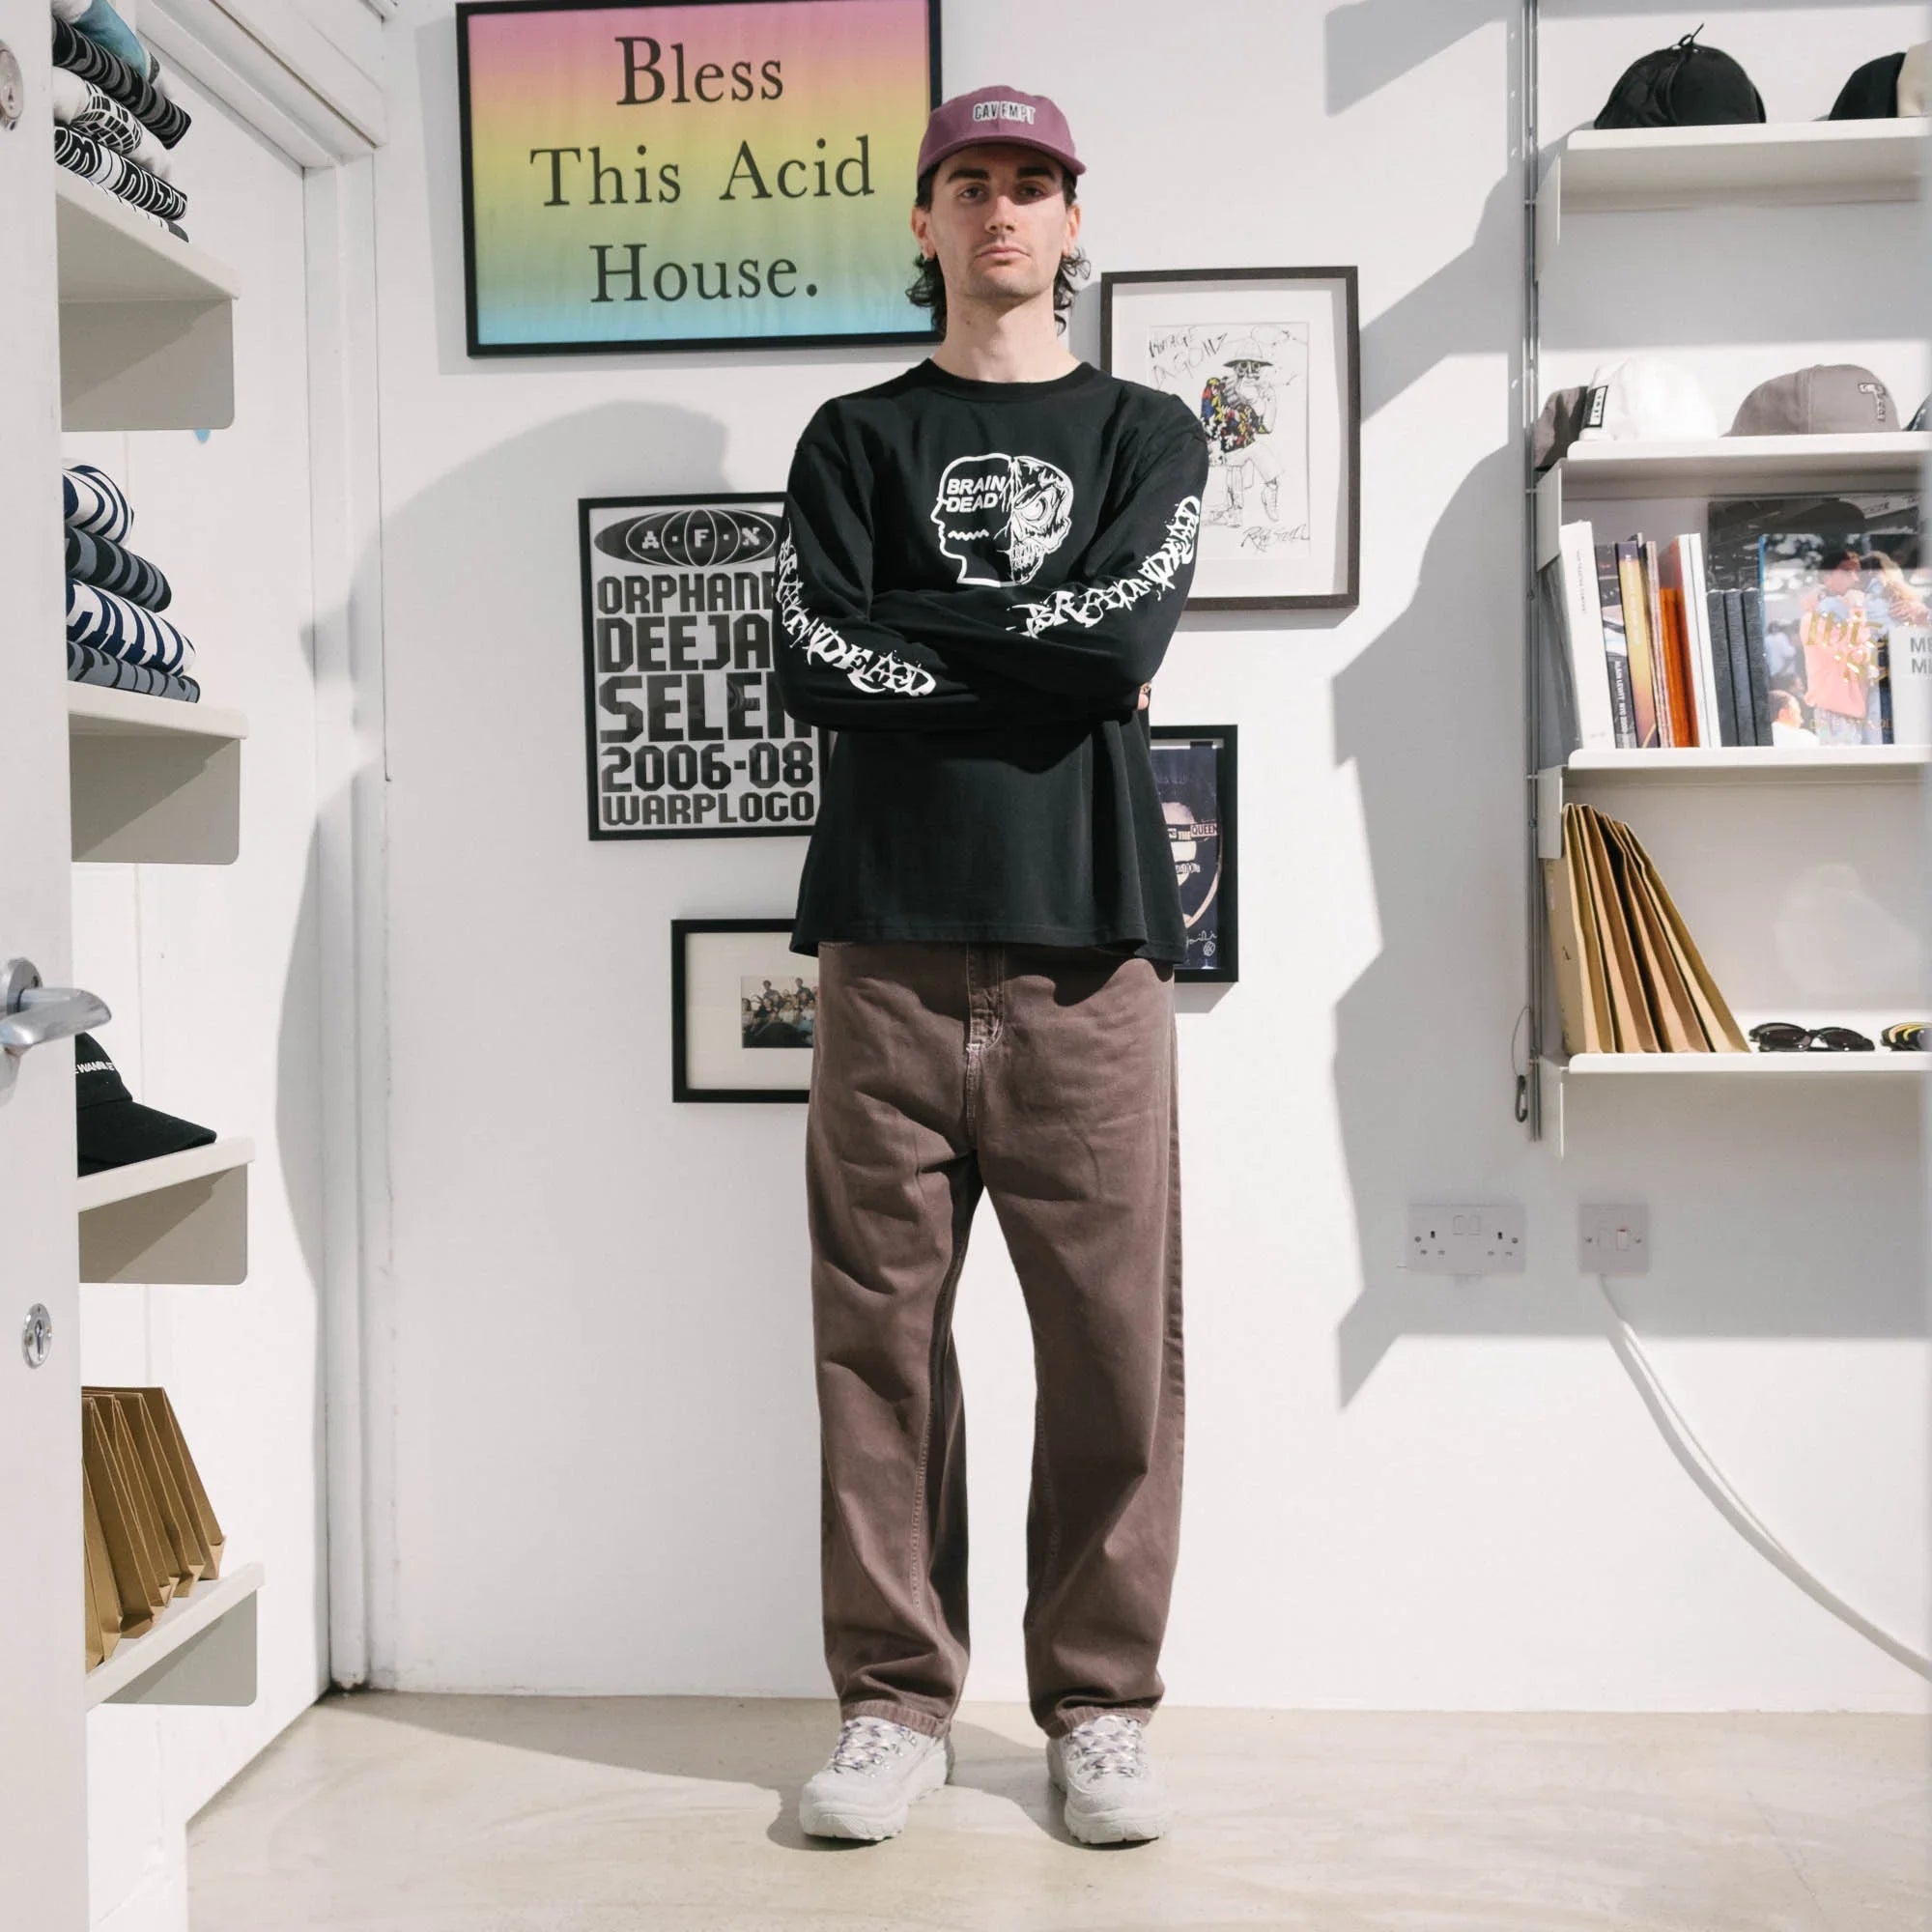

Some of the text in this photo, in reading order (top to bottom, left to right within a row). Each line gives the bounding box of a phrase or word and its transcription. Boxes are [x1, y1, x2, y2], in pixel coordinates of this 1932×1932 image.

[615, 36, 784, 105] Bless
[529, 135, 875, 208] This Acid
[589, 243, 820, 304] House.
[946, 492, 999, 513] DEAD
[947, 474, 1007, 496] BRAIN
[600, 740, 814, 793] 2006-08
[601, 791, 814, 827] WARPLOGO
